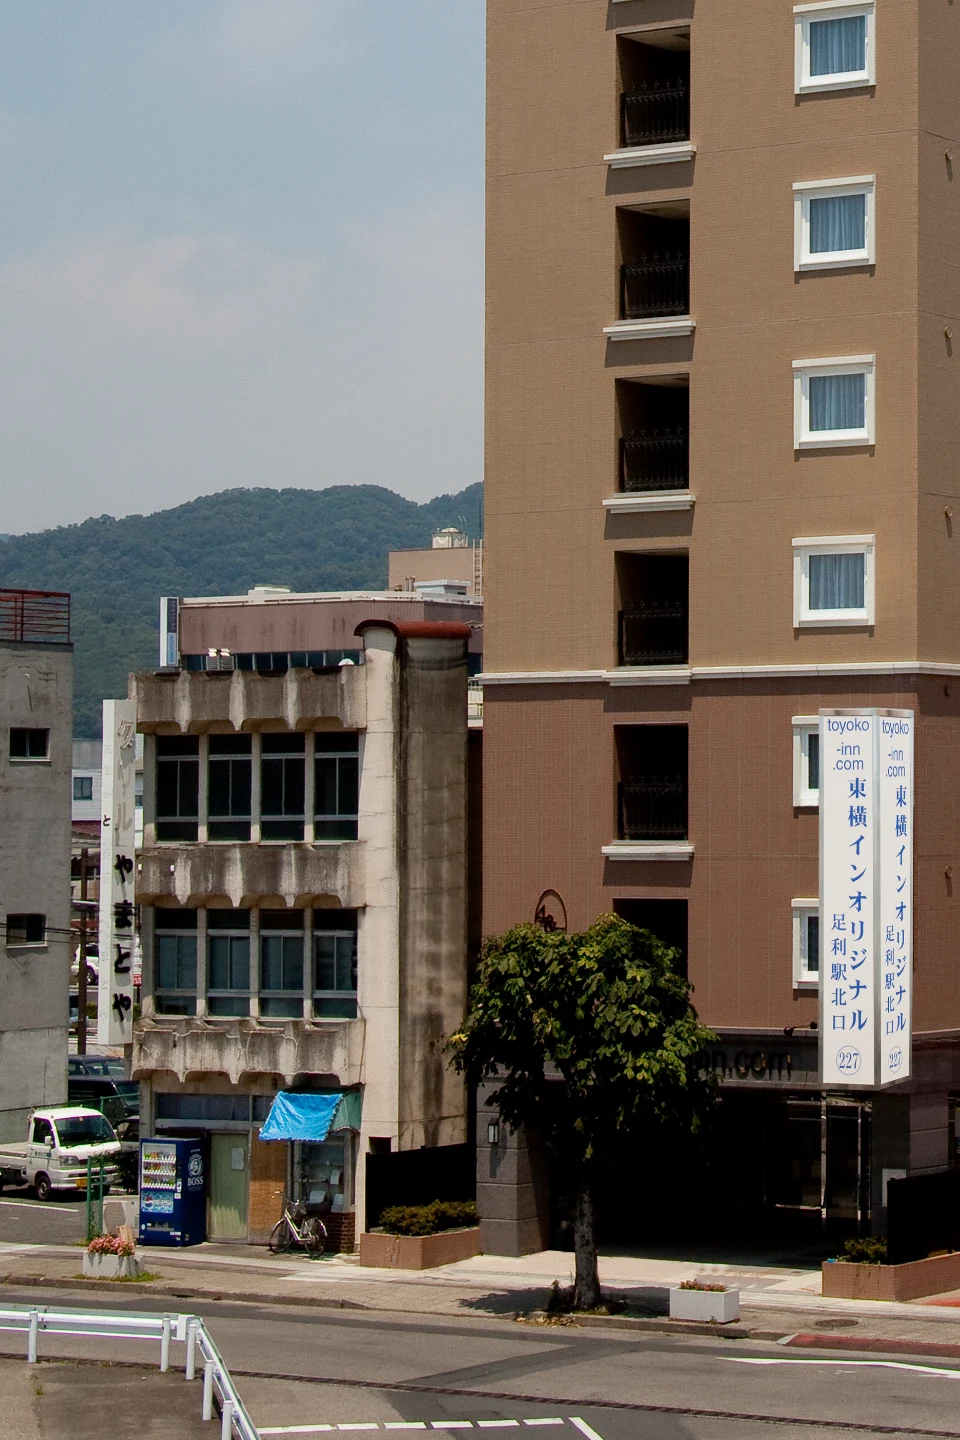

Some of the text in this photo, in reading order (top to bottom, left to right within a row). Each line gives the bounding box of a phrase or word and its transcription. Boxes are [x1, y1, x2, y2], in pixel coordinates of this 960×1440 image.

[827, 718, 870, 735] toyoko
[882, 719, 909, 738] toyoko
[836, 742, 861, 756] -inn
[888, 747, 904, 761] -inn
[832, 759, 864, 771] .com
[885, 765, 906, 778] .com
[848, 777, 868, 1031] 東横インオリジナル
[895, 785, 907, 1032] 東横インオリジナル
[831, 913, 847, 1031] 足利駅北口
[885, 925, 895, 1035] 足利駅北口
[839, 1052, 858, 1069] 227
[888, 1051, 902, 1070] 227
[187, 1176, 204, 1187] BOSS
